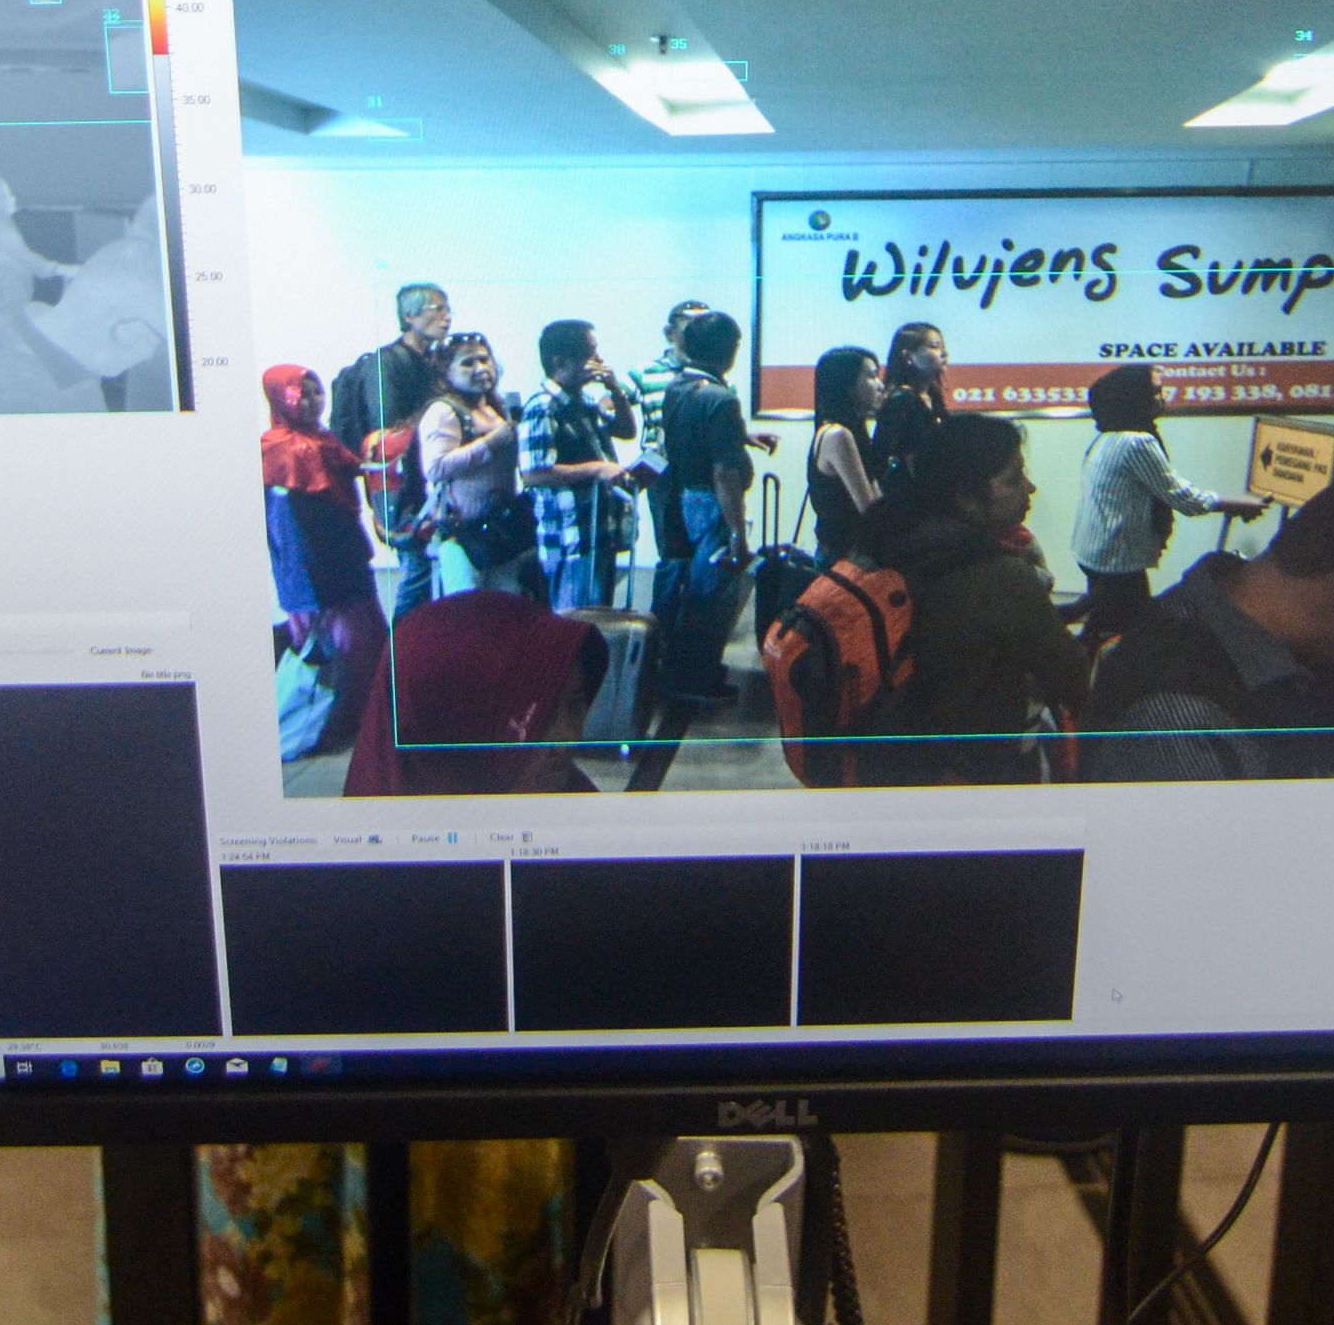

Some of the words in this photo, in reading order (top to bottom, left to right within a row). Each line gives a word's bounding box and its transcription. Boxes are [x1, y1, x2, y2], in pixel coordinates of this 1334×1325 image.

[176, 2, 205, 14] 40.00
[1294, 30, 1313, 42] 34
[670, 38, 688, 50] 35
[183, 94, 211, 106] 35.00
[189, 183, 217, 196] 30.00
[781, 233, 825, 242] ANGKASA
[826, 232, 850, 241] PURA
[195, 270, 224, 282] 25.00
[1099, 342, 1179, 359] SPACE
[1184, 340, 1327, 358] AVAILABLE
[201, 355, 232, 368] 20.00
[1153, 363, 1229, 378] Contact
[1231, 363, 1257, 377] Us
[953, 387, 995, 403] 021
[1183, 386, 1226, 401] 193
[1230, 384, 1283, 402] 338,
[90, 645, 122, 655] Current
[124, 645, 153, 657] Image
[219, 835, 267, 848] Screening
[334, 834, 362, 845] Visual
[411, 832, 440, 844] Pause
[489, 831, 515, 842] Clear
[544, 846, 560, 856] PM
[834, 841, 851, 851] PM
[256, 851, 271, 861] PM
[718, 1099, 819, 1127] DELL
